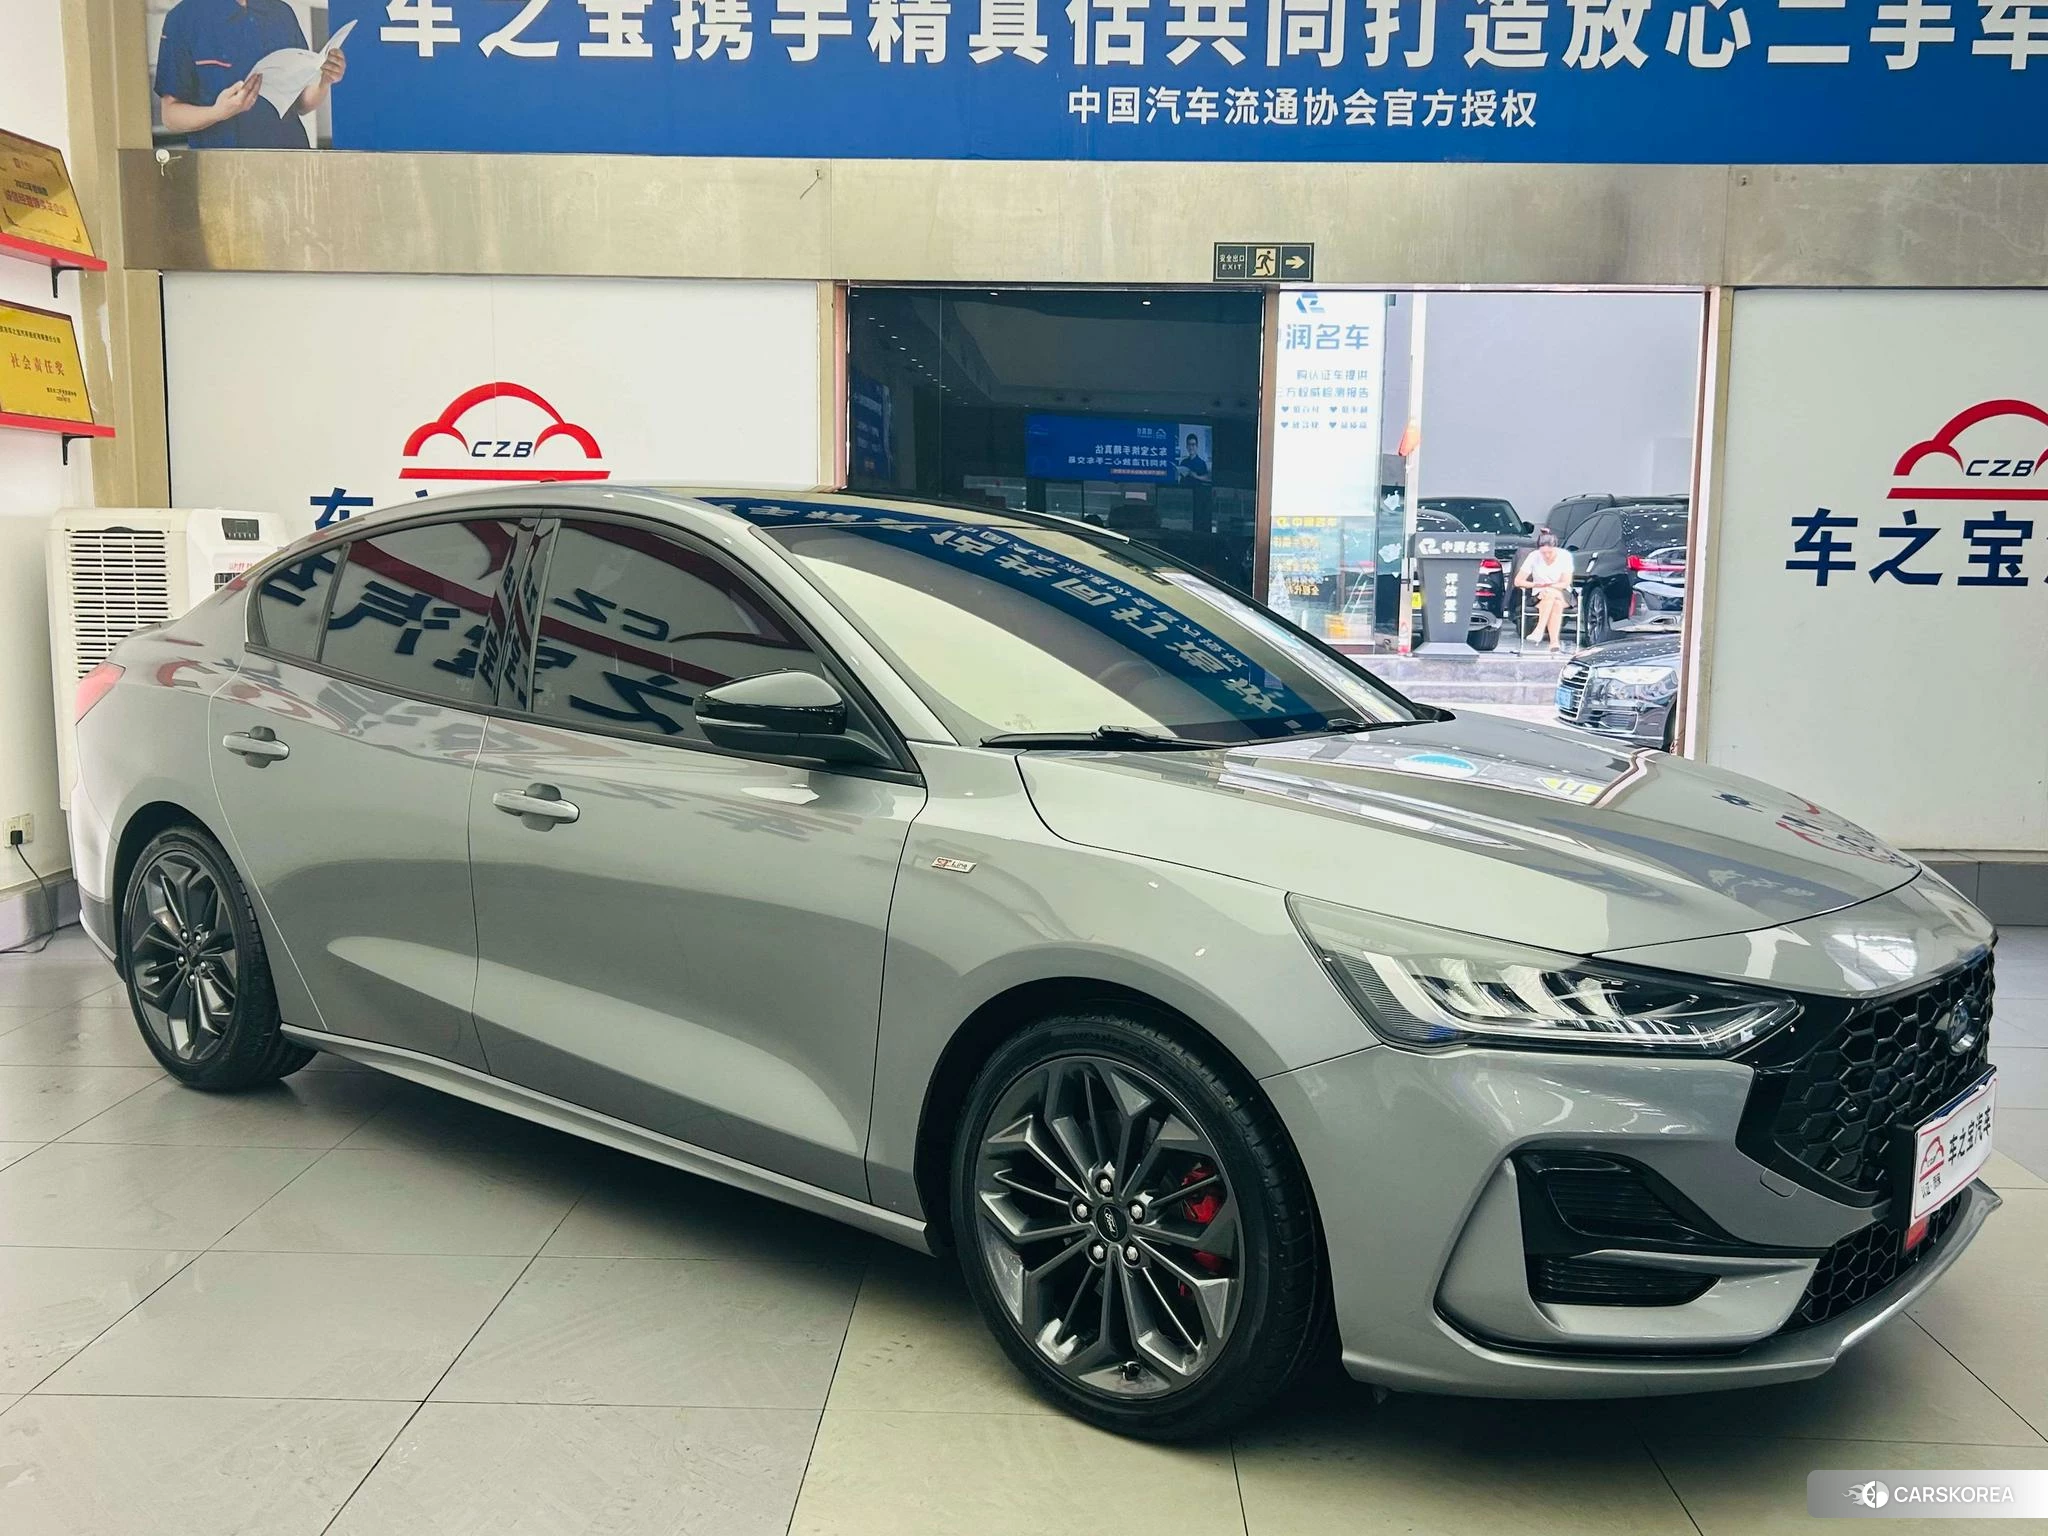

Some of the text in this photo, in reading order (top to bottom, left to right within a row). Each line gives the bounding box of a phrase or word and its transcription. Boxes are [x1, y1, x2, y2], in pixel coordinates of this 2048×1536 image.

[1067, 85, 1537, 128] 中国汽车流通协会官方授权
[1219, 254, 1245, 263] 安全出口
[1285, 323, 1370, 350] 润名车
[471, 441, 534, 458] CZB
[1965, 459, 2036, 477] CZB
[1785, 507, 2048, 587] 车之宝
[1948, 1105, 1991, 1166] 车之宝汽车
